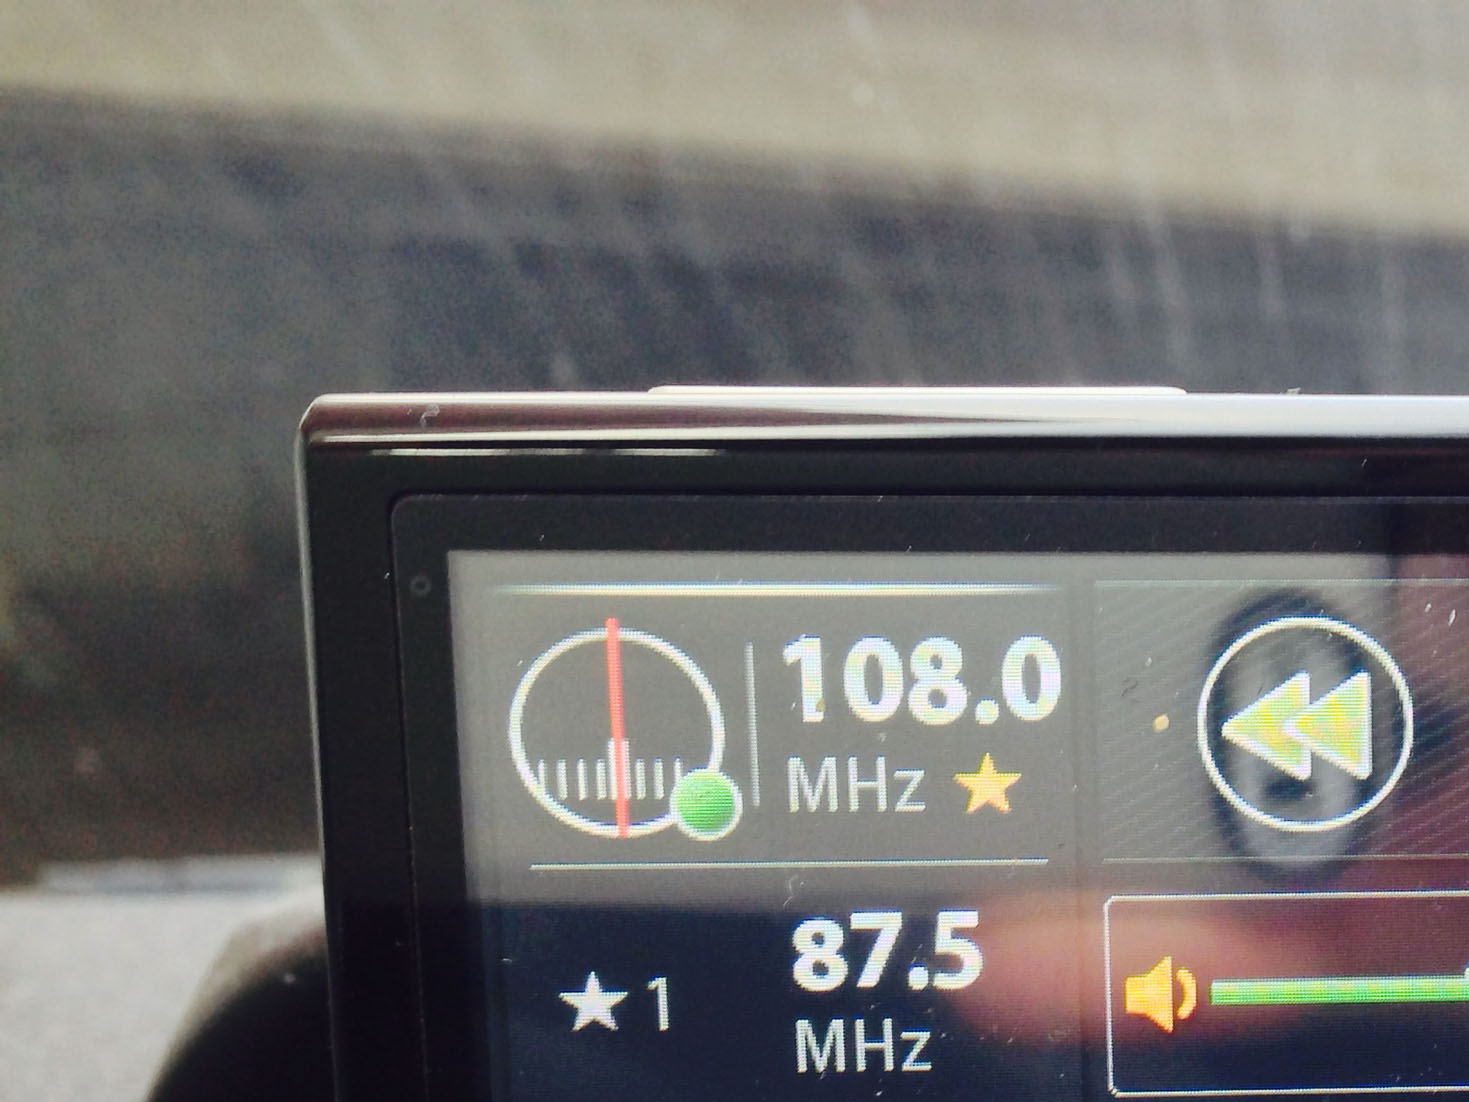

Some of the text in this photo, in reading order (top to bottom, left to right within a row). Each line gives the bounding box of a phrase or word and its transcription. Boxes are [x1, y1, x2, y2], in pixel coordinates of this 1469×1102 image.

[784, 635, 1061, 724] 108.0
[788, 756, 926, 812] MHz
[792, 909, 983, 992] 87.5
[648, 976, 669, 1030] 1
[796, 1017, 932, 1072] MHz
